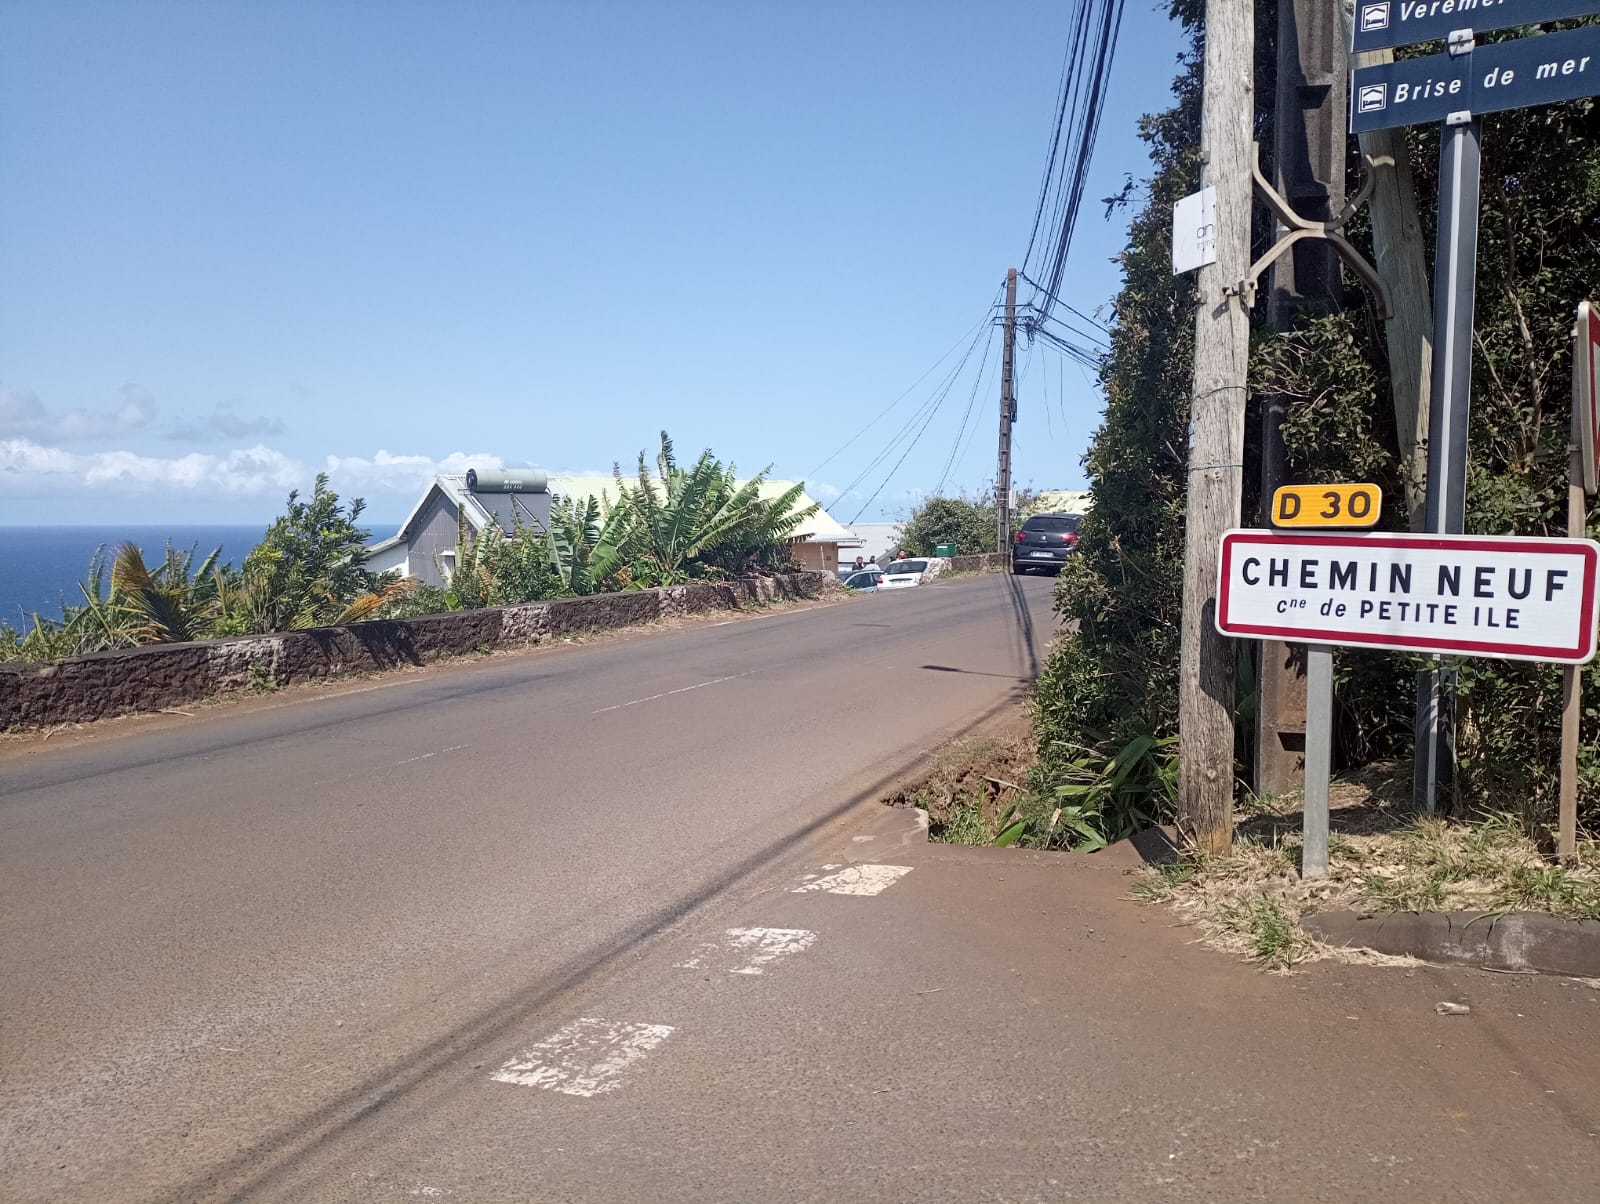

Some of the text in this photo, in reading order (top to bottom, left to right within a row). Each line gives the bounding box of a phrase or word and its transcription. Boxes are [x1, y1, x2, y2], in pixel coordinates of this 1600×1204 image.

[1401, 0, 1504, 21] Verem
[1393, 56, 1591, 104] Brise de mer
[1279, 491, 1372, 520] D 30
[1242, 557, 1569, 601] CHEMIN NEUF
[1320, 598, 1347, 617] de
[1360, 600, 1458, 625] PETITE
[1474, 606, 1520, 629] ILE
